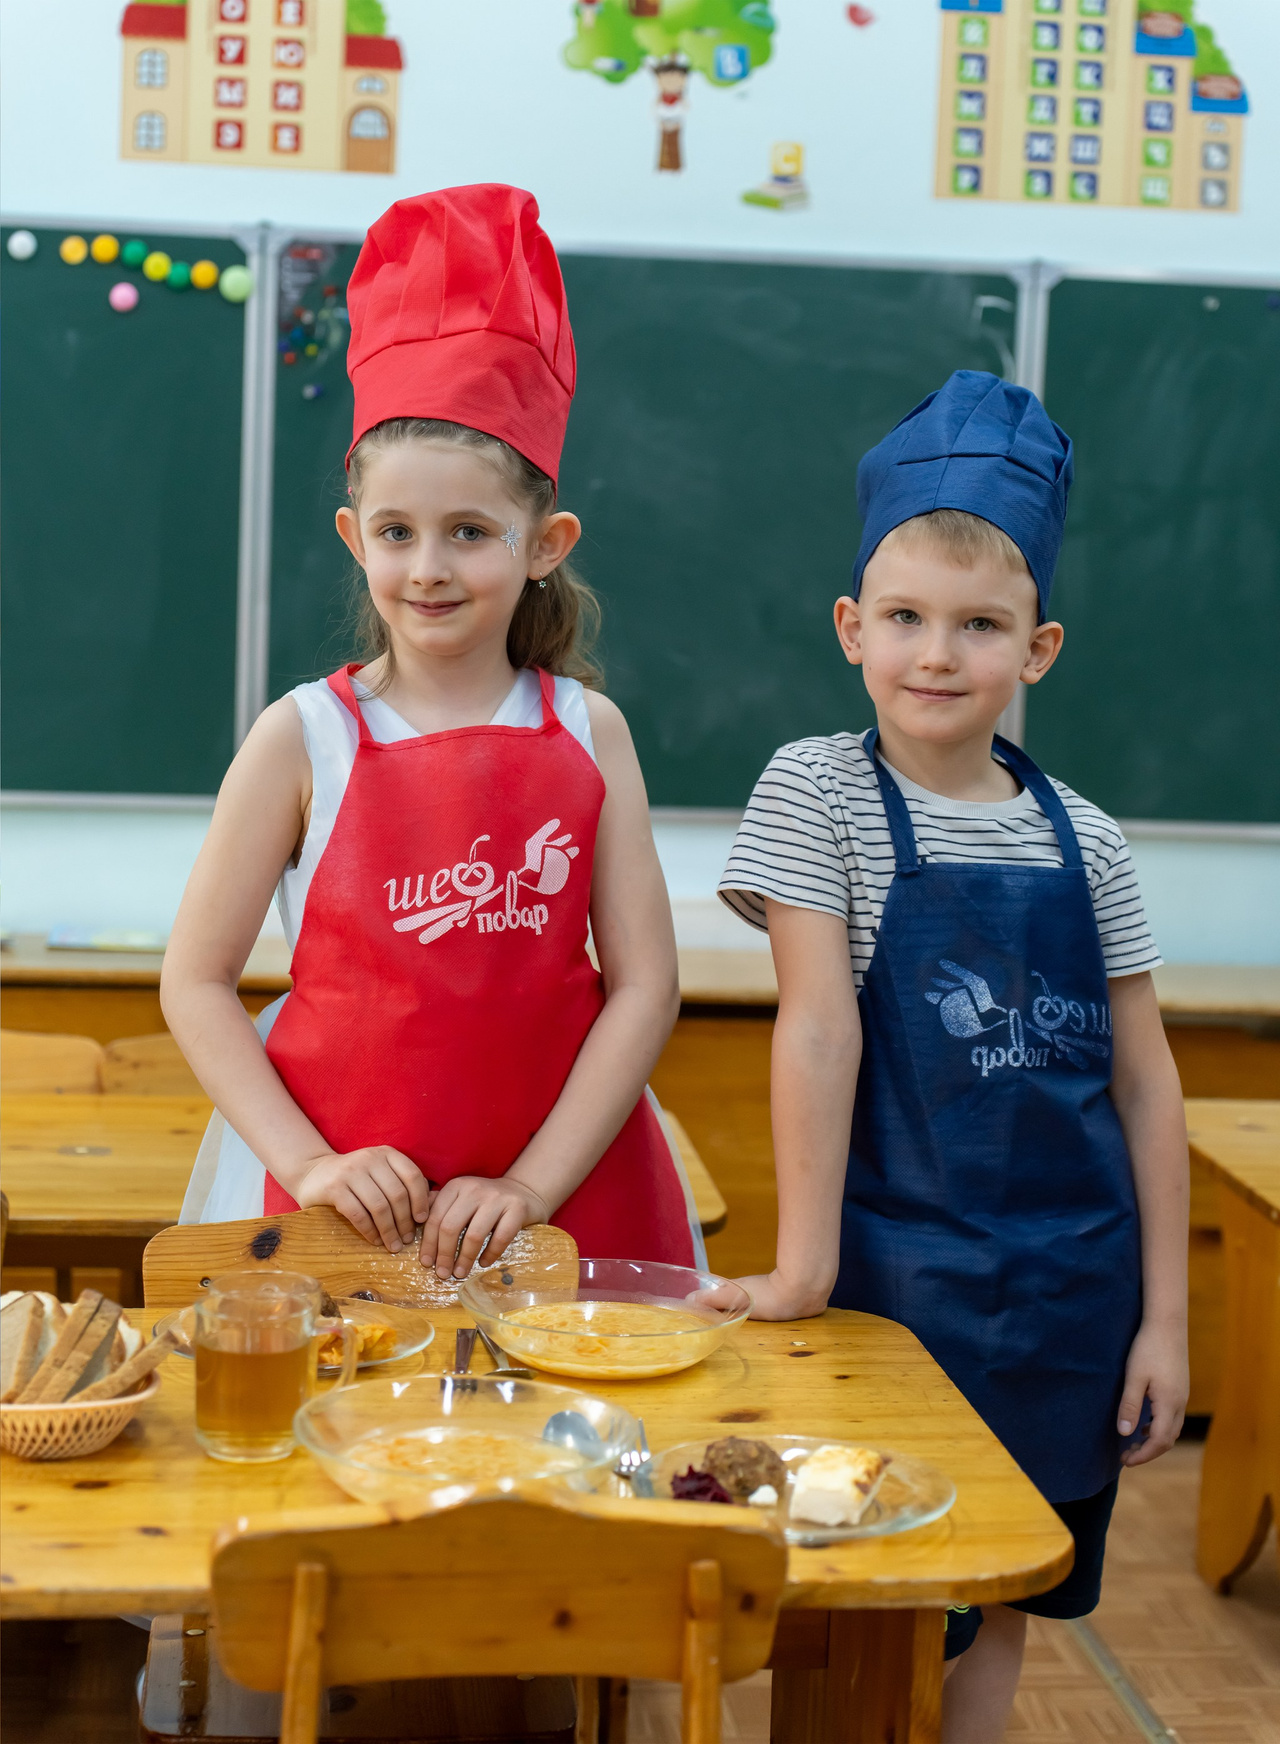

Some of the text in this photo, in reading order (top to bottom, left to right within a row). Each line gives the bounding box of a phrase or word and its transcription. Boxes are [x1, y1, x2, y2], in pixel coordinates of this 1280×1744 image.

[221, 39, 304, 65] У Ю
[475, 870, 550, 936] повар
